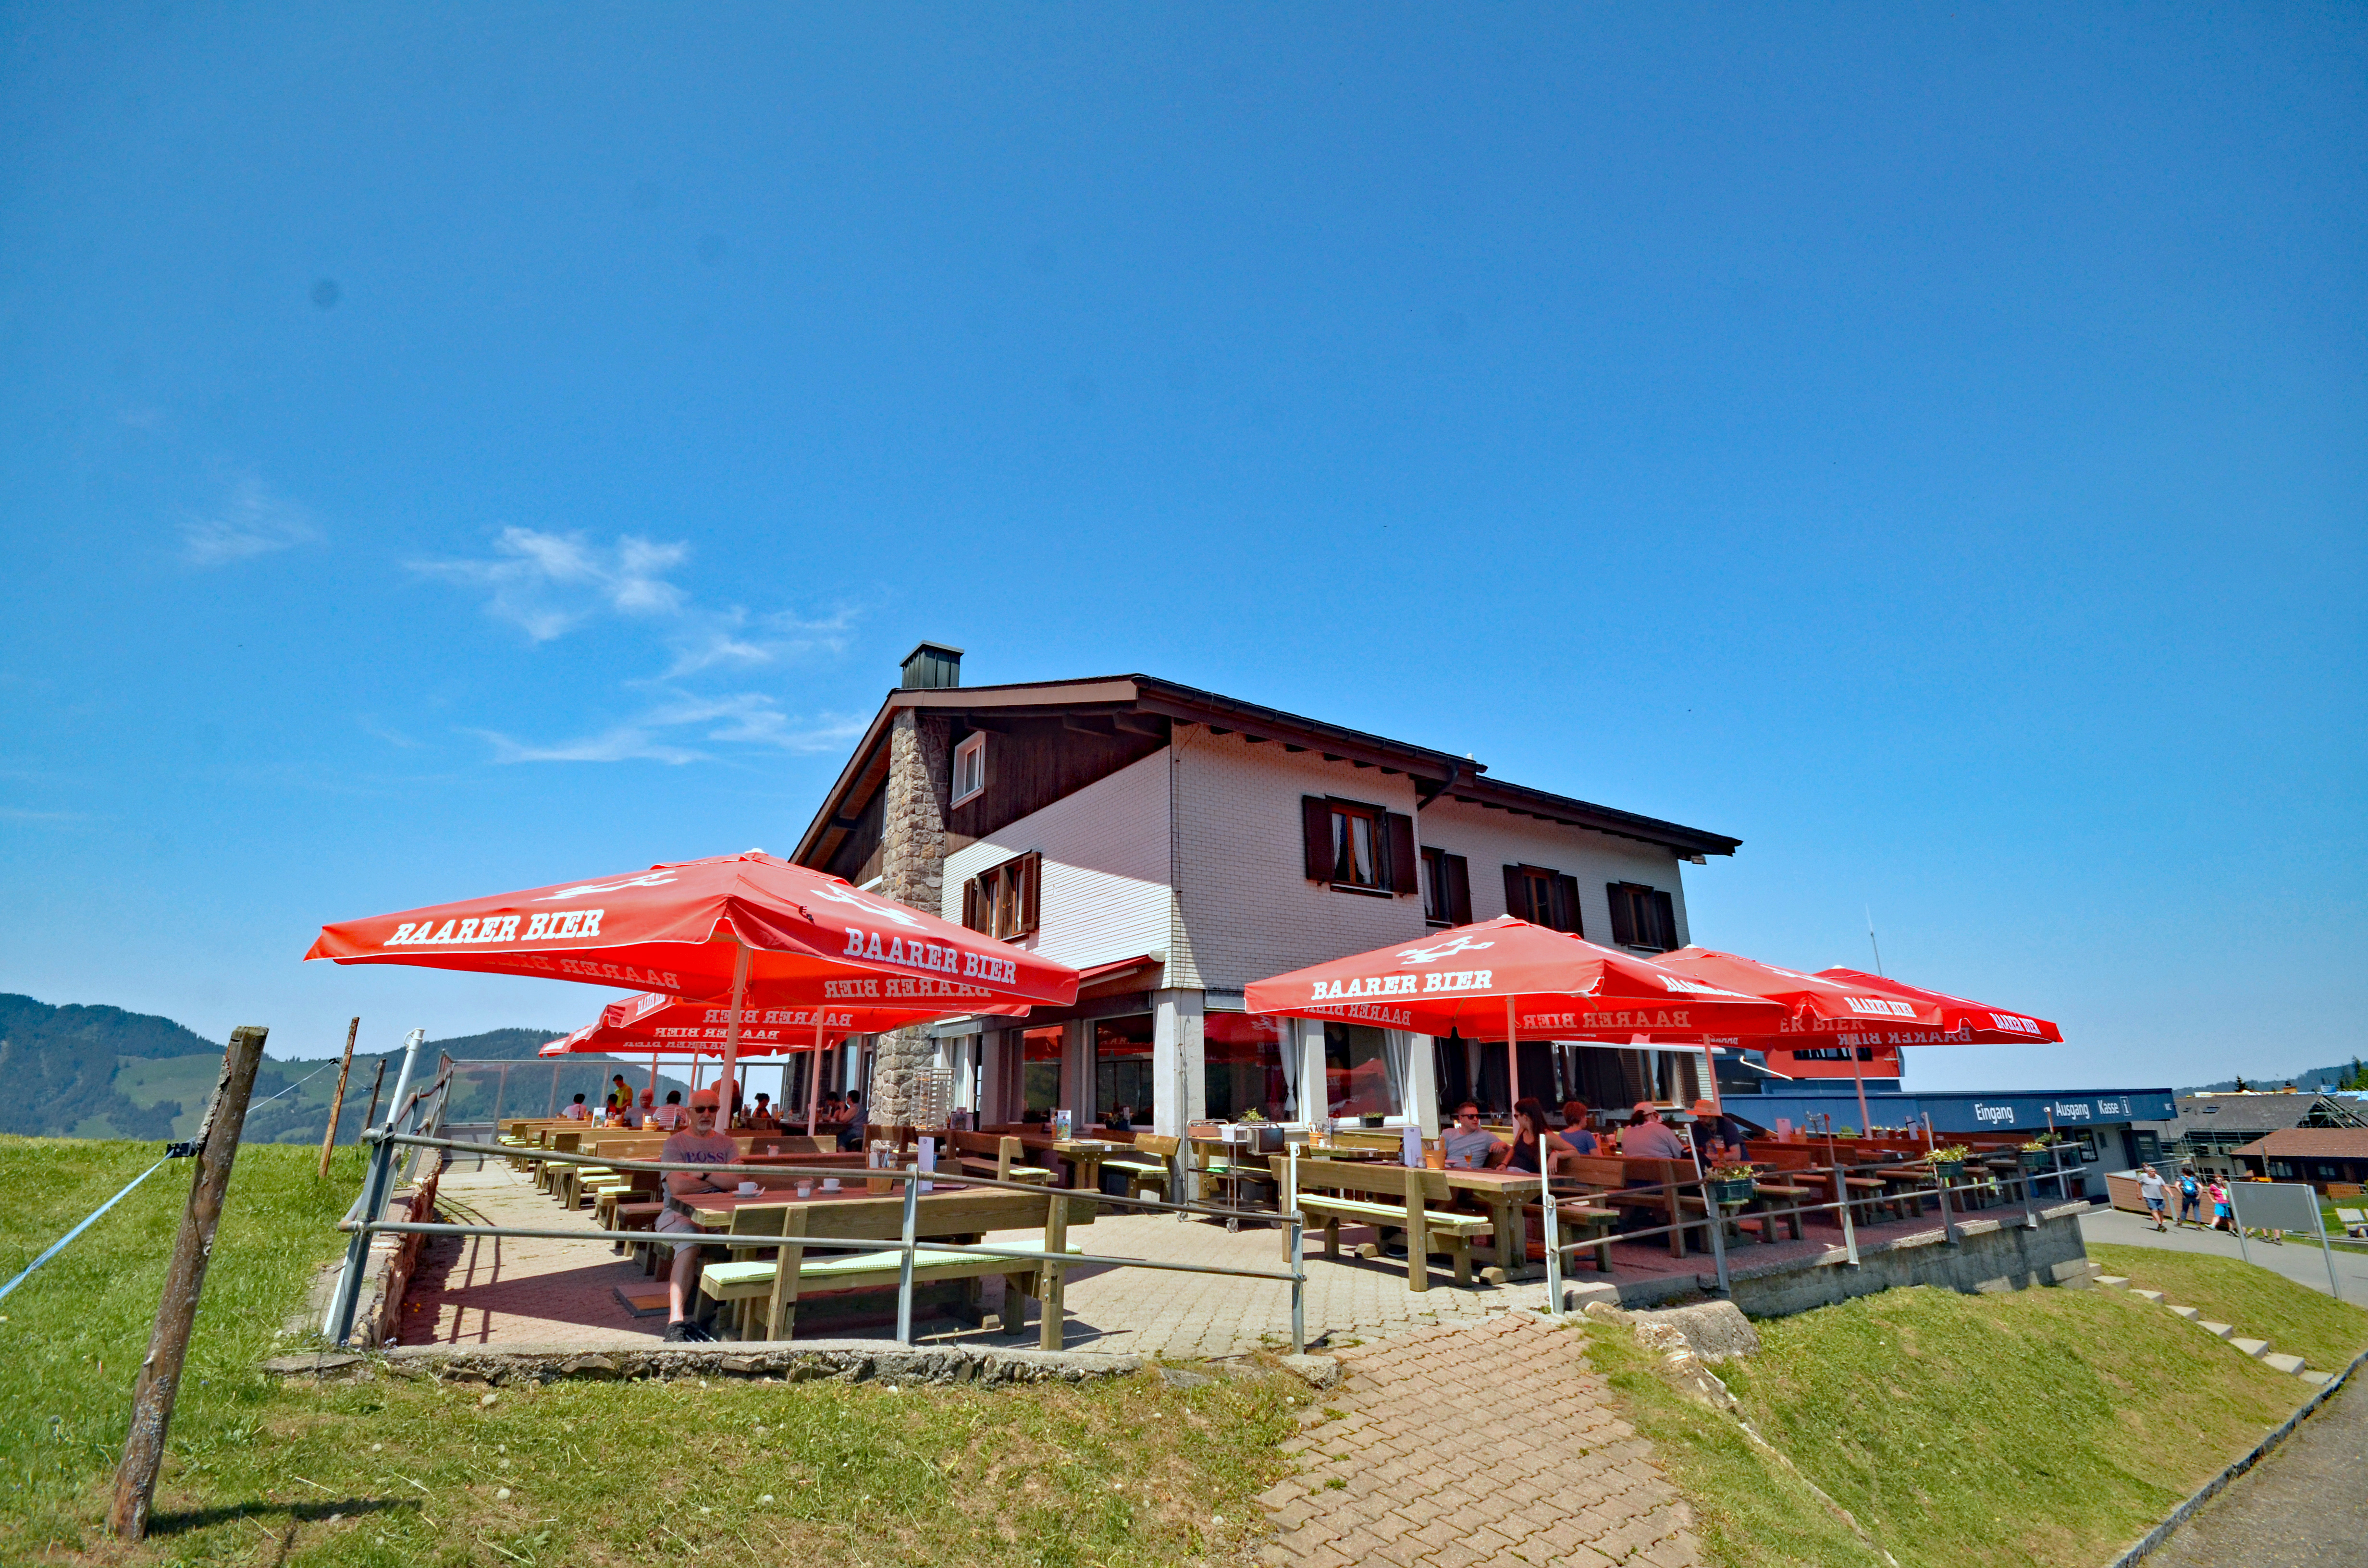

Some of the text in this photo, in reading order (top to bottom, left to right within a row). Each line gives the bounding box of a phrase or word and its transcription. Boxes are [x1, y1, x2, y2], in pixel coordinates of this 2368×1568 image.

[383, 909, 604, 946] BAARER BIER
[843, 927, 1016, 984] BAARER BIER
[1311, 970, 1492, 1000] BAARER BIER
[1843, 997, 1917, 1018] BAARER BIER
[1974, 1103, 2013, 1124] Eingang
[2056, 1101, 2090, 1120] Ausgang
[2097, 1100, 2120, 1115] Kasse
[686, 1151, 725, 1164] BOSS
